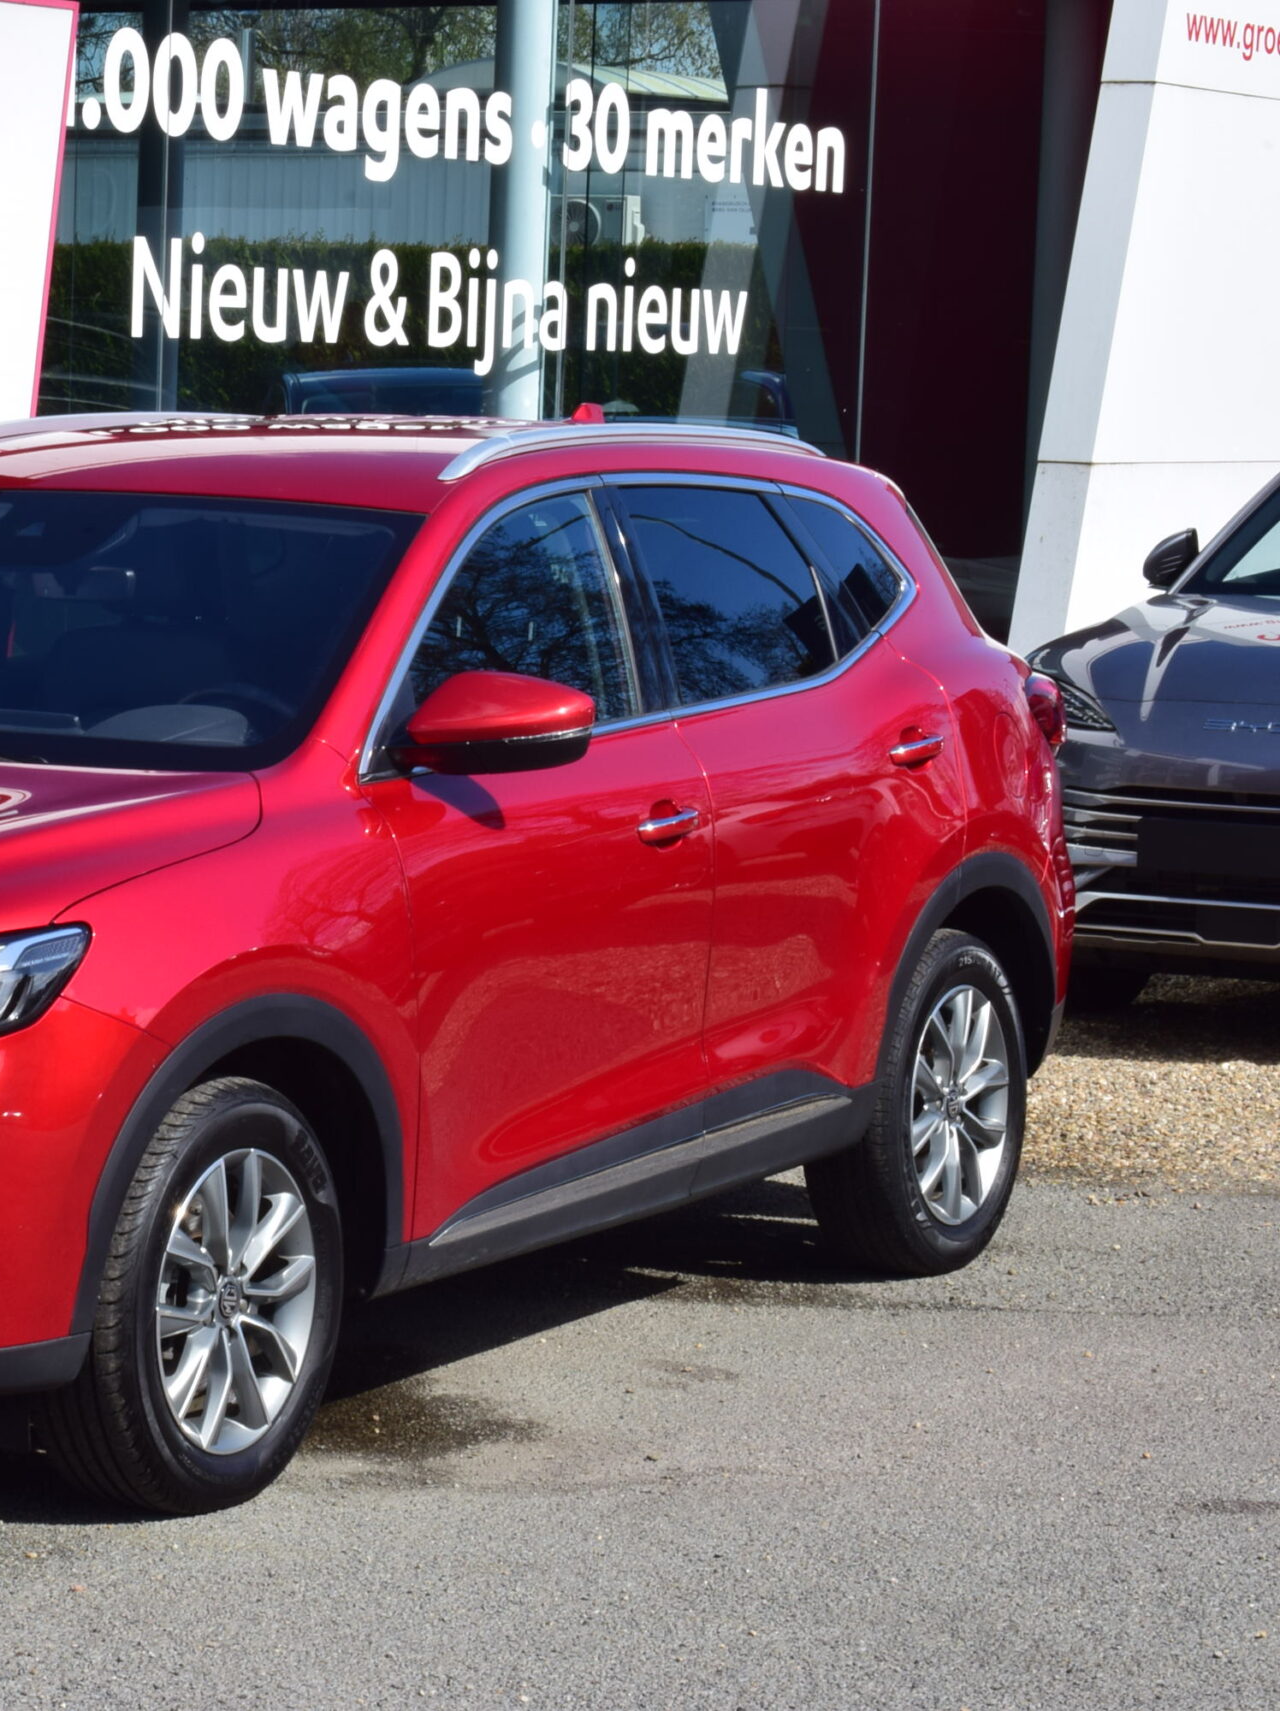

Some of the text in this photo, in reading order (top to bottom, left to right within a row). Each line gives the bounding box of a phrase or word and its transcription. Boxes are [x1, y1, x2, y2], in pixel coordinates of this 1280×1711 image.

[1186, 12, 1280, 62] www.gro
[66, 27, 845, 194] .000 wagens 30 merken
[131, 232, 748, 377] Nieuw & Bijna nieuw
